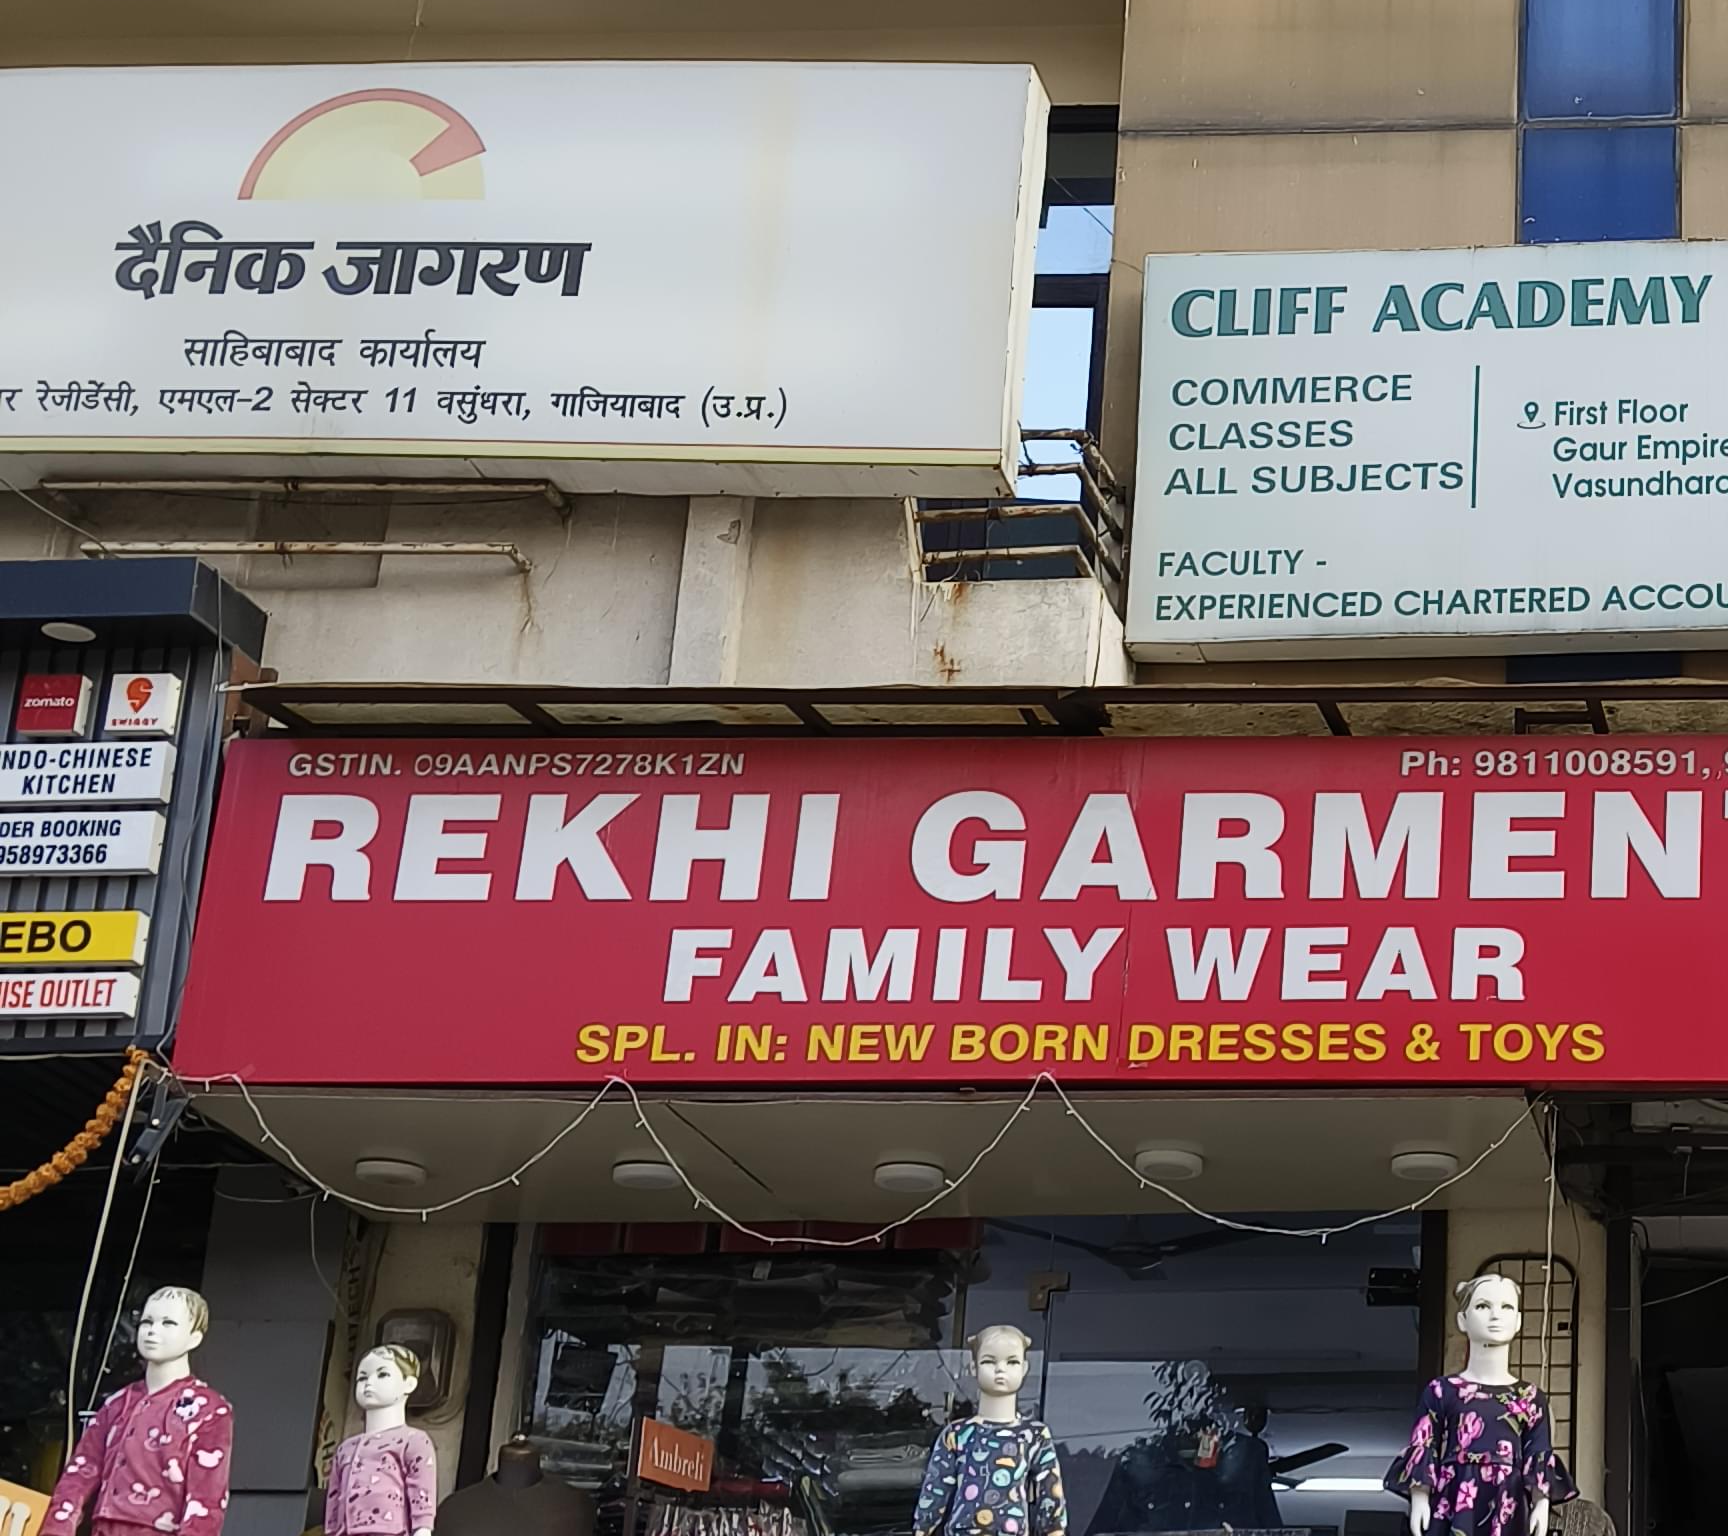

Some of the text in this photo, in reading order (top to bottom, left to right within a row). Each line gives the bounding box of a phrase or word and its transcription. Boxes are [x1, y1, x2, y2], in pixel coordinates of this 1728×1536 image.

[114, 219, 591, 301] दैनिक जागरण
[1171, 274, 1713, 338] CLIFF ACADEMY
[184, 329, 486, 370] साहिबाबाद कार्यालय
[159, 386, 274, 414] एमएल-2
[290, 381, 369, 414] सेक्टर
[385, 387, 418, 414] 11
[437, 385, 531, 424] वसुंधरा,
[551, 386, 685, 419] गाजियाबाद
[1172, 375, 1412, 406] COMMERCE
[1554, 398, 1688, 427] First Floor
[1169, 420, 1353, 451] CLASSES
[1552, 438, 1627, 462] Gaur
[1164, 462, 1464, 496] ALL SUBJECTS
[1156, 591, 1382, 621] EXPERIENCED
[1394, 586, 1591, 615] CHARTERED
[24, 695, 75, 708] zomato
[22, 774, 116, 796] KITCHEN
[262, 792, 840, 902] REKHI
[663, 924, 1527, 1004] FAMILY WEAR
[577, 1023, 1606, 1064] SPL. IN: NEW BORN DRESSES & TOYS
